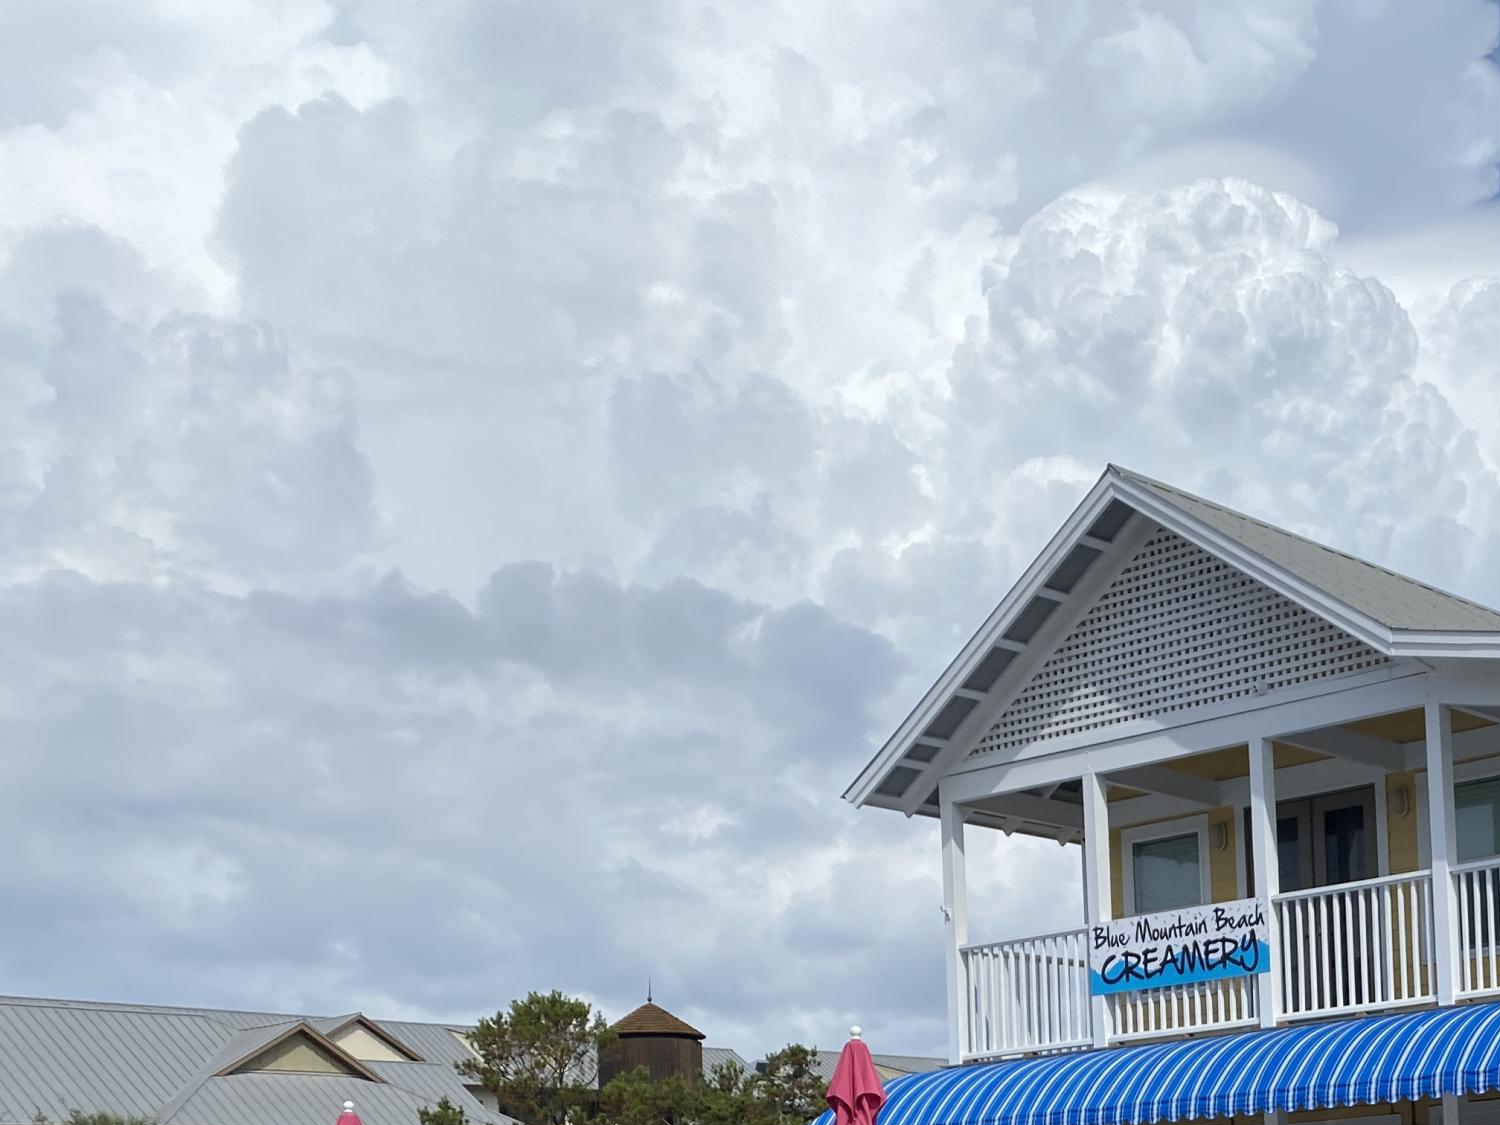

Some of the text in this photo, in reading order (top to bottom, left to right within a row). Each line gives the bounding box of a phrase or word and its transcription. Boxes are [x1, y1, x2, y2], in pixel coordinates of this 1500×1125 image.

[1093, 903, 1265, 950] Blue Mountain Beach
[1101, 928, 1259, 985] CREAMERY
